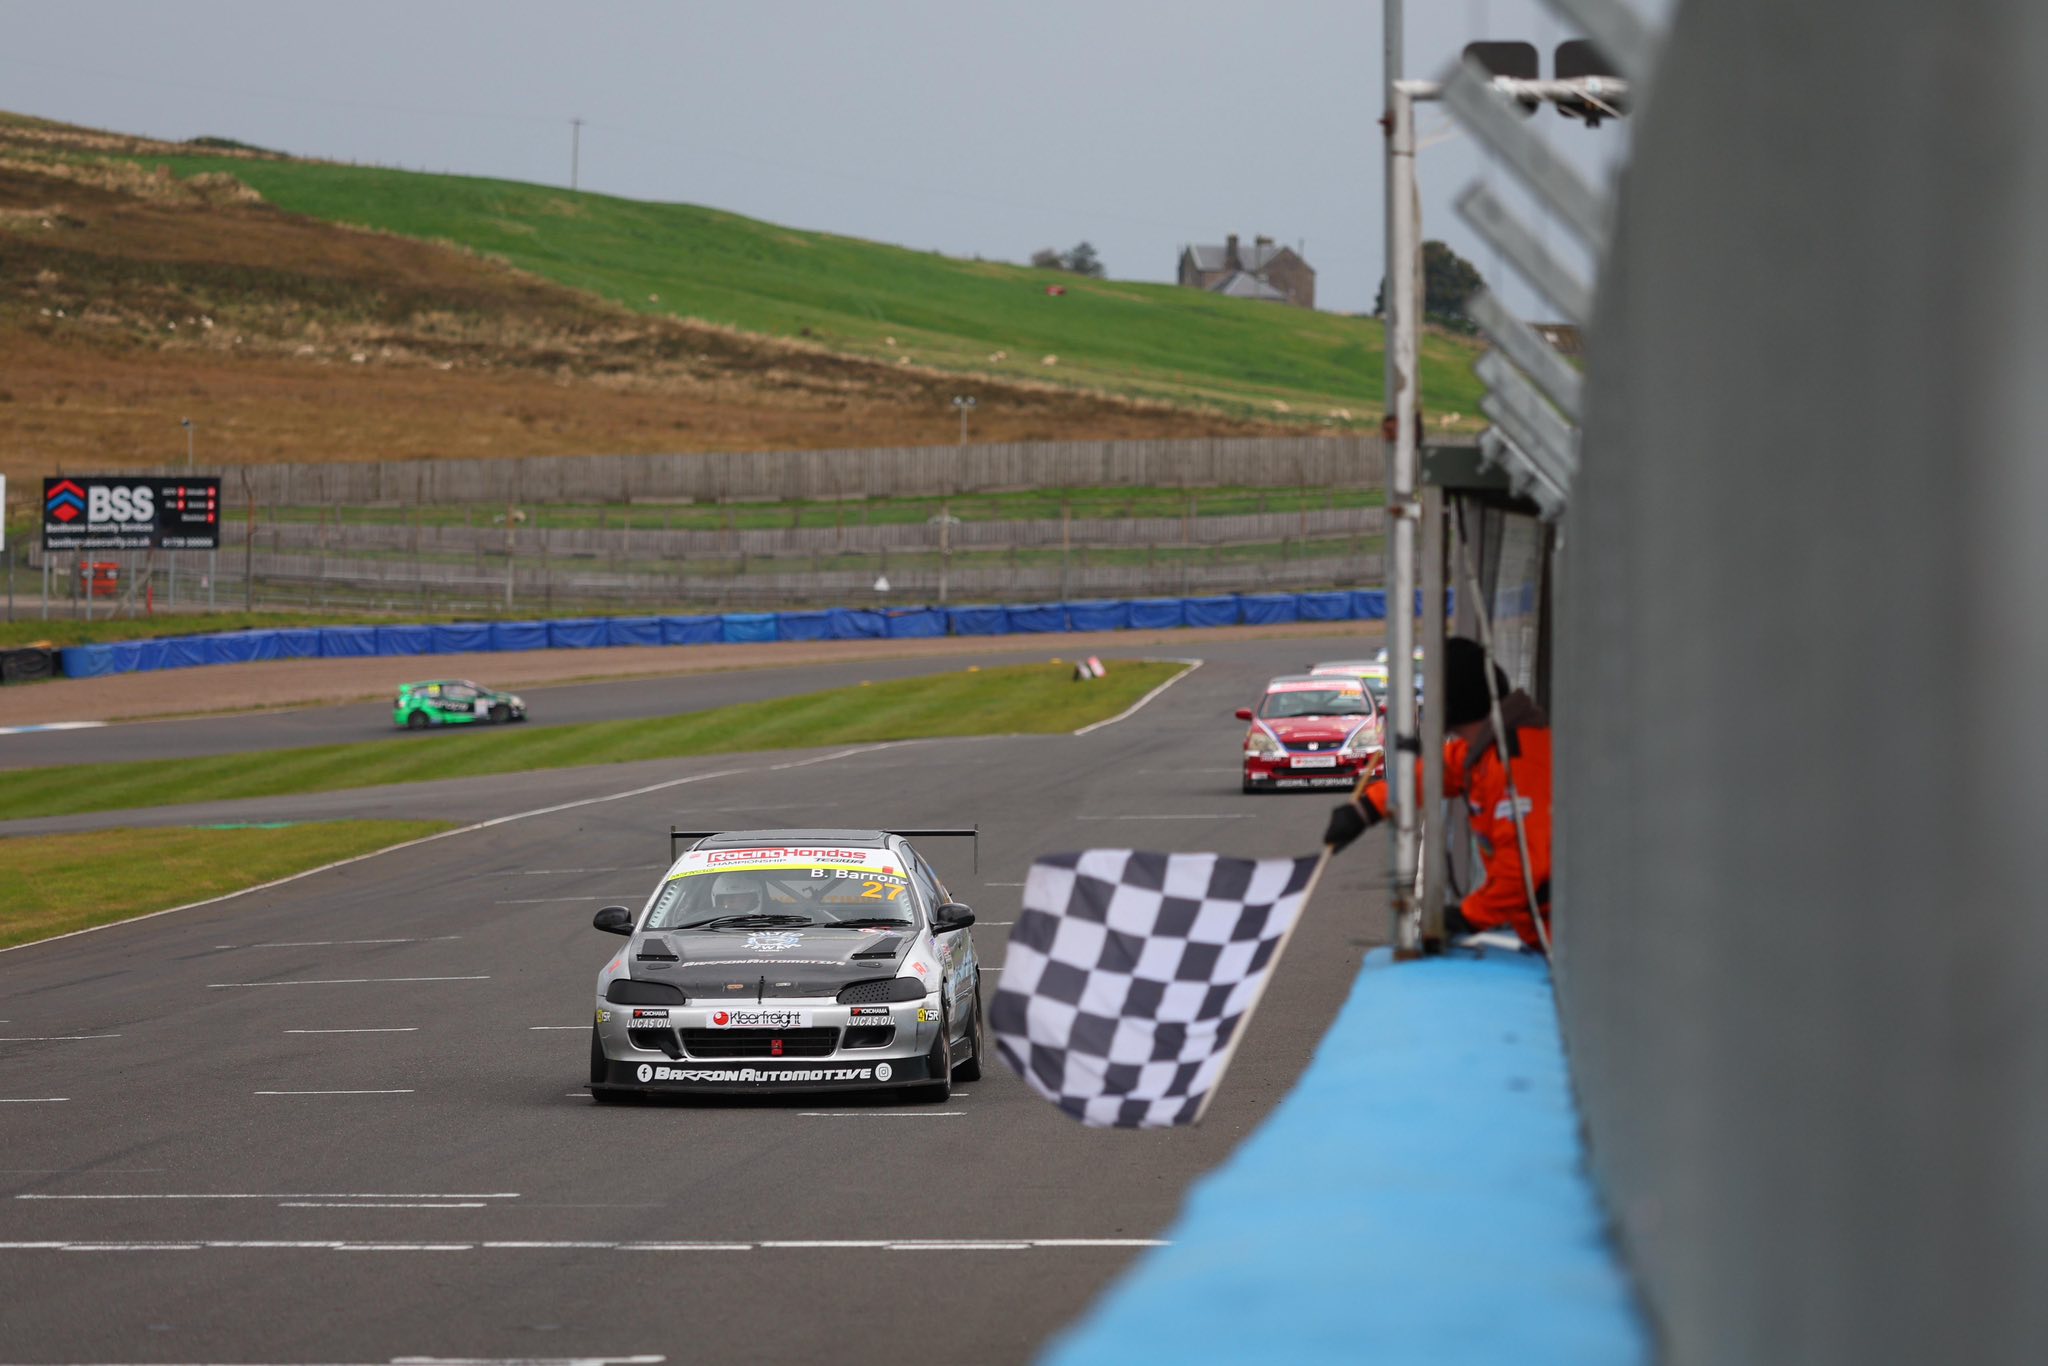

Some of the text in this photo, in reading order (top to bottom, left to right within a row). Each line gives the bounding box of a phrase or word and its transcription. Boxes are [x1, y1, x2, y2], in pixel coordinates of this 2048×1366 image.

[88, 486, 154, 522] BSS
[706, 858, 787, 868] CHAMPIONSHIP
[810, 868, 899, 885] B. Barron
[861, 881, 905, 901] 27
[730, 1010, 801, 1029] Kleerfreight
[846, 1015, 896, 1026] LUCAS OIL
[925, 1009, 939, 1021] YSR
[626, 1019, 672, 1028] LUCAS OIL
